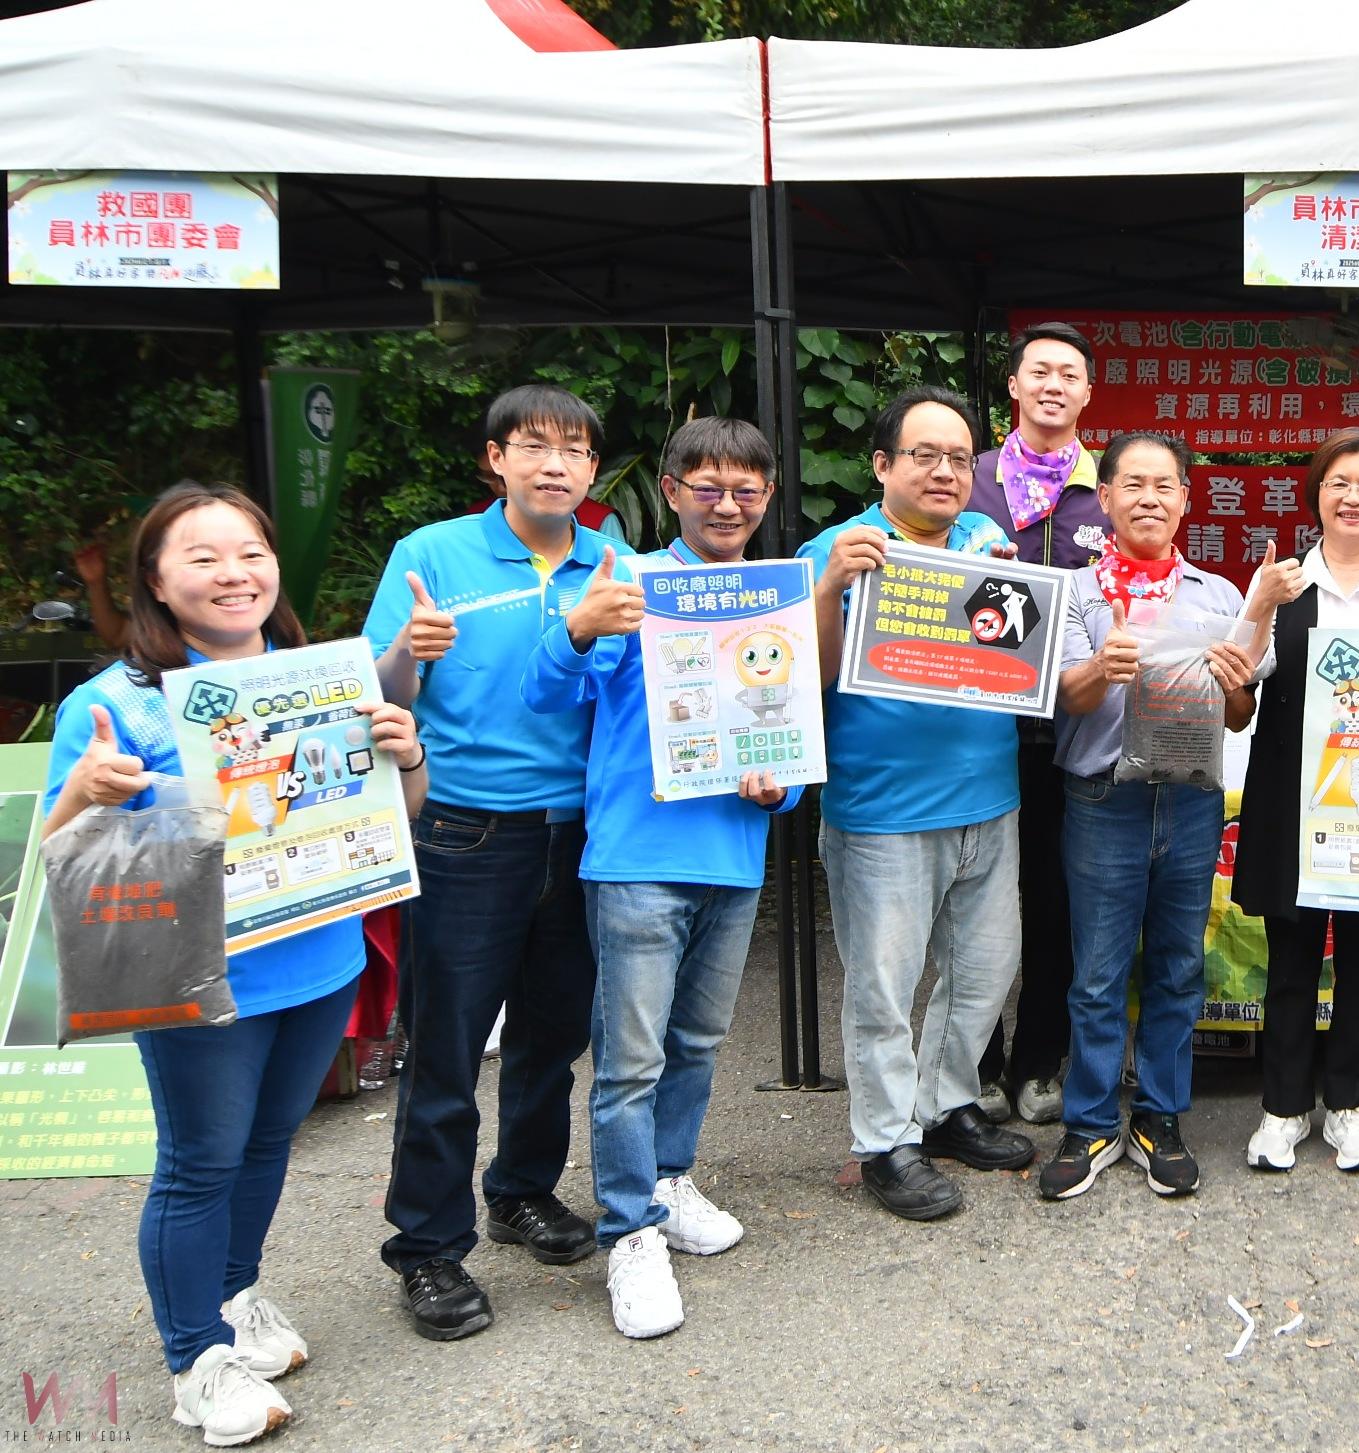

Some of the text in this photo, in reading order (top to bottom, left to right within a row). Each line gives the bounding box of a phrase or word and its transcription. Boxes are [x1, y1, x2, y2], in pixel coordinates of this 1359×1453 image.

[97, 191, 194, 219] 救國團
[48, 220, 242, 250] 員林市團委會
[654, 574, 742, 594] 回收廢照明
[676, 588, 778, 612] 環境有光明
[310, 678, 363, 707] LED
[276, 771, 306, 801] VS
[315, 786, 347, 801] LED
